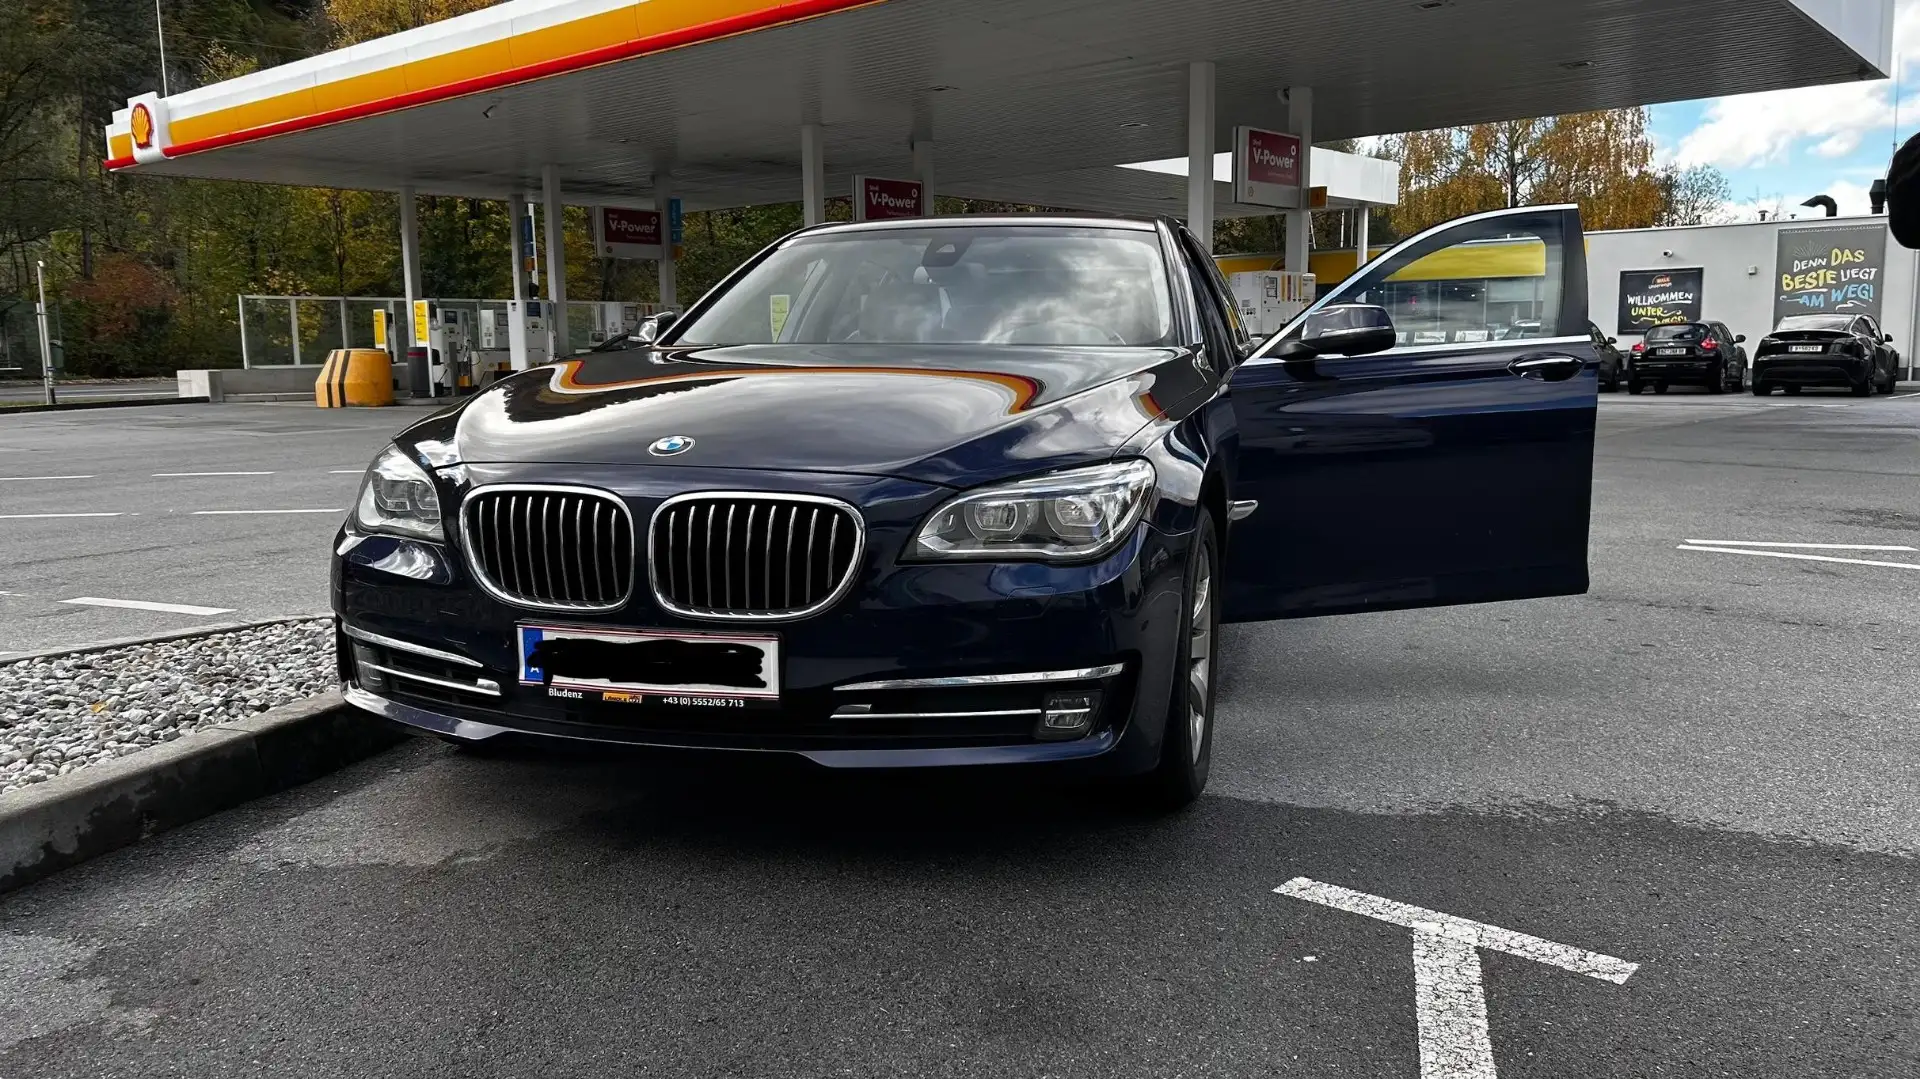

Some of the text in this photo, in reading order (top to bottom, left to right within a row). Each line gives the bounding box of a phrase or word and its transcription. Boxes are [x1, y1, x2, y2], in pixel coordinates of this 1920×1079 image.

[1253, 147, 1294, 168] V-Power
[870, 192, 916, 208] V-Power
[609, 219, 656, 233] V-Power
[1793, 248, 1865, 272] DENN DAS
[1782, 268, 1877, 290] BESTE LIEGT
[1627, 291, 1693, 305] WILLKOMMEN
[1799, 284, 1873, 307] AM WEG!
[548, 688, 583, 699] Bludenz
[662, 696, 745, 708] +43 (0) 5552/65 713
